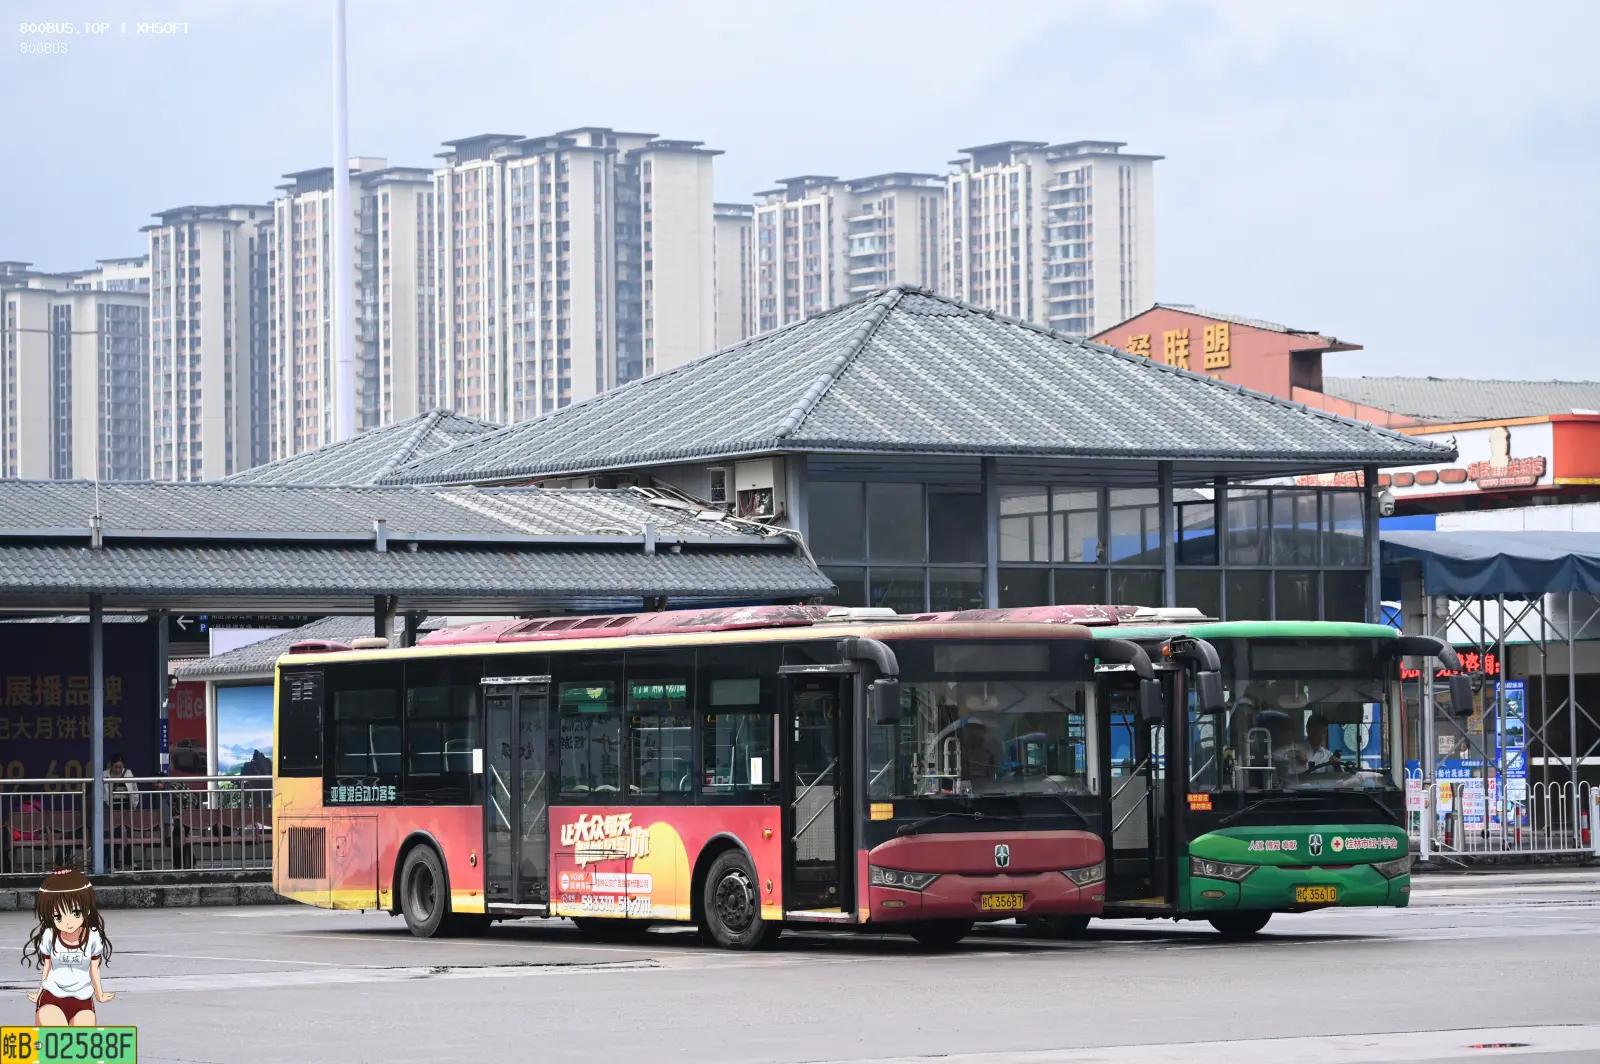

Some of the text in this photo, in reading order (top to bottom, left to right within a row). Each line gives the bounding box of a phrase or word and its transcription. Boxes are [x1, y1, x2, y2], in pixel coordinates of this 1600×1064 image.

[1097, 322, 1231, 371] 餐联盟
[331, 785, 396, 802] 亚星混合动力客车
[1248, 839, 1264, 851] 人道
[1345, 837, 1398, 850] 桂林市红十字会
